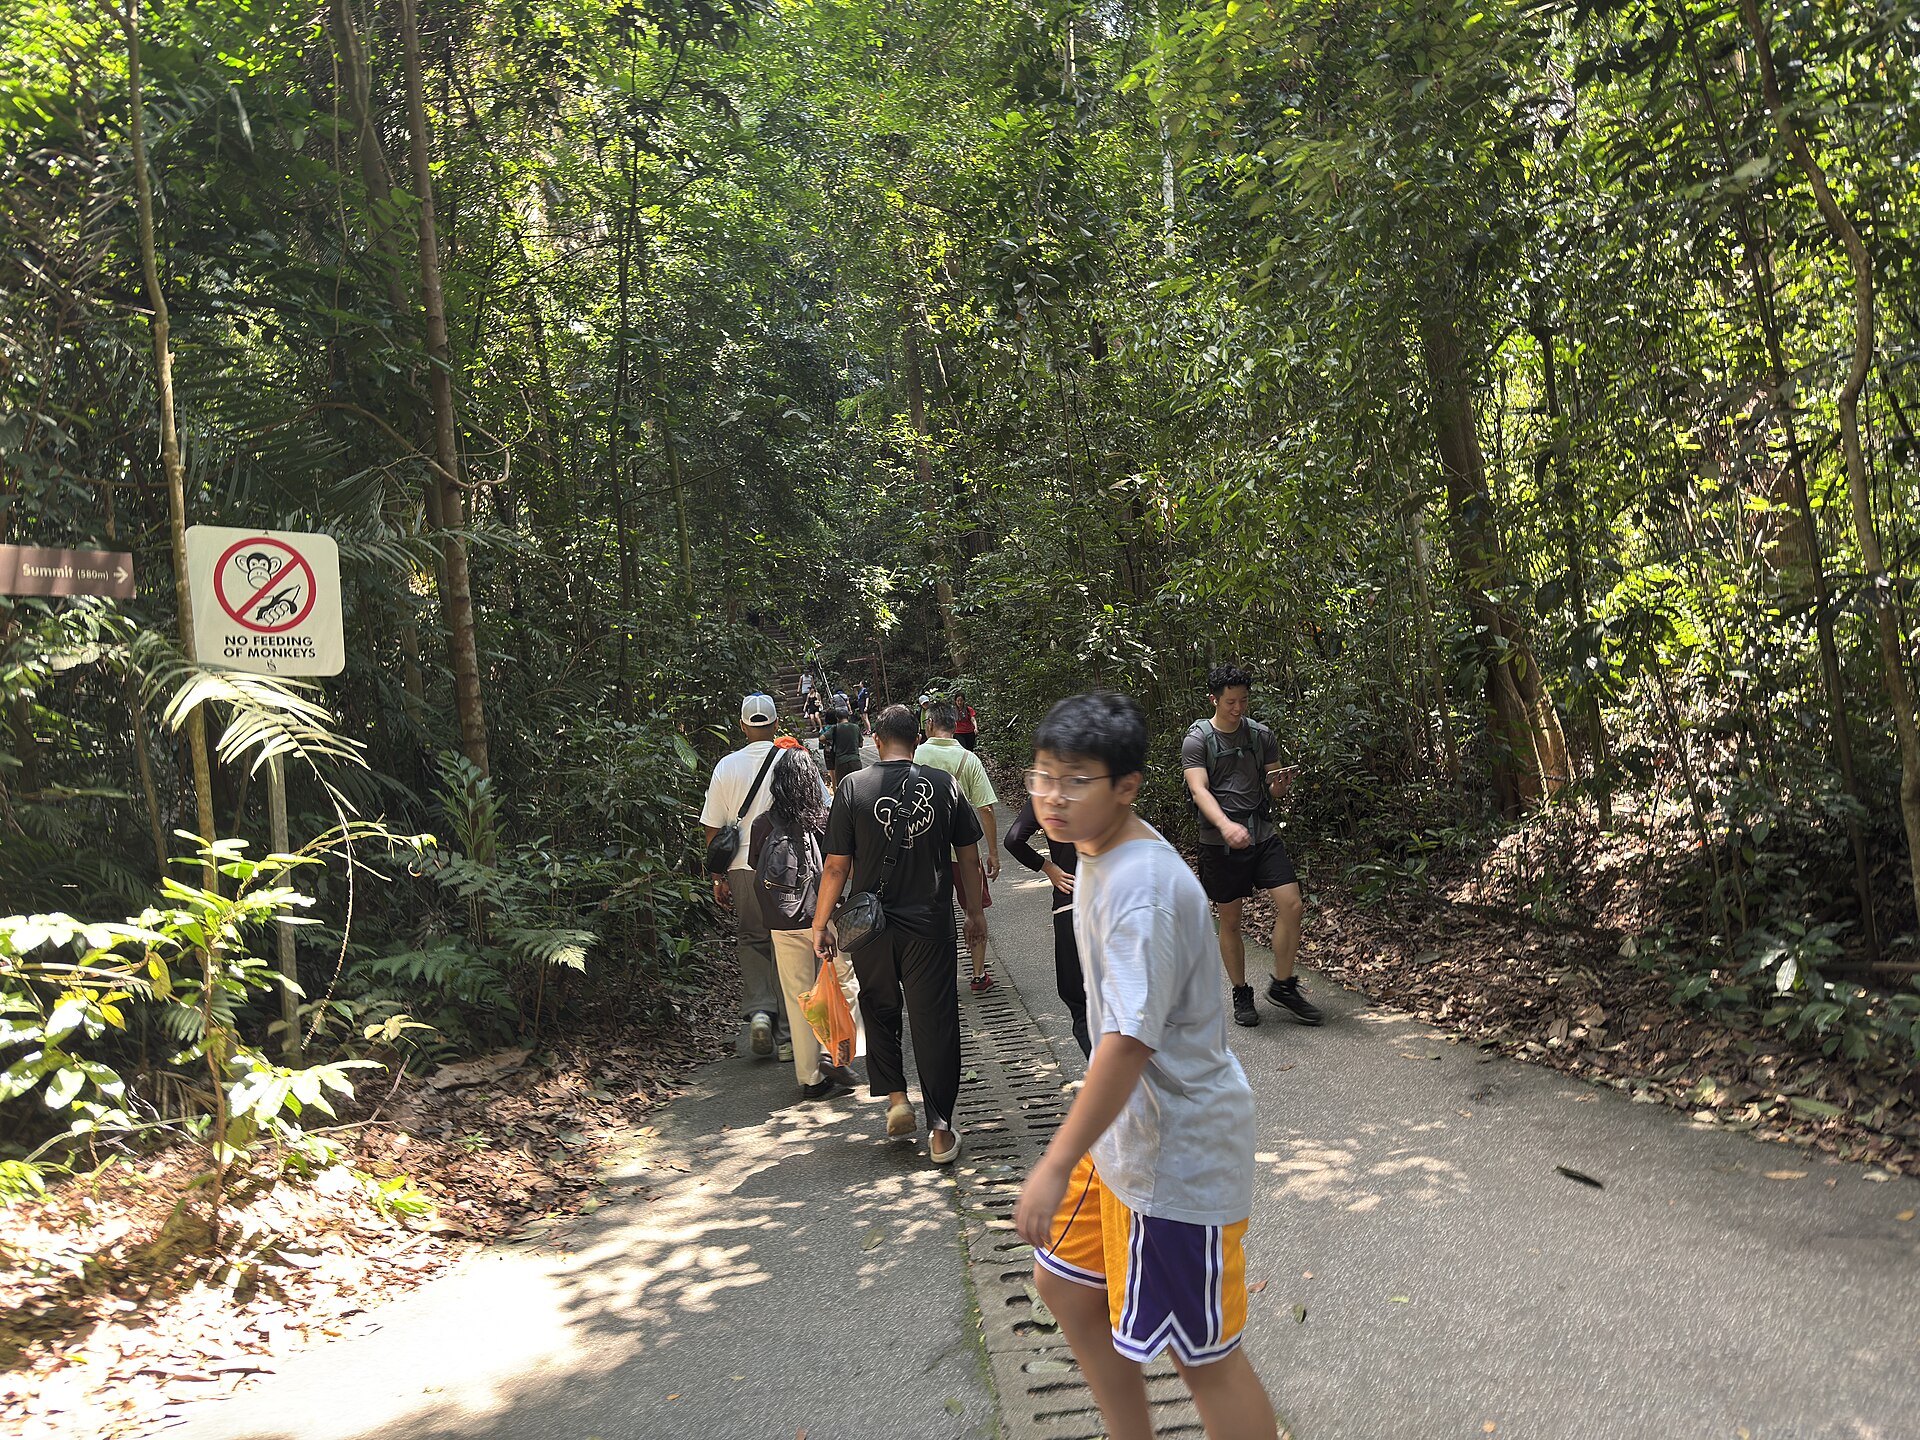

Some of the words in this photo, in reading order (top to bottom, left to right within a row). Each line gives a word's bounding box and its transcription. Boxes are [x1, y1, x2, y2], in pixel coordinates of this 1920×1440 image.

[22, 562, 74, 579] Summit
[224, 635, 248, 647] NO
[253, 635, 313, 647] FEEDING
[223, 647, 243, 658] OF
[247, 647, 316, 658] MONKEYS
